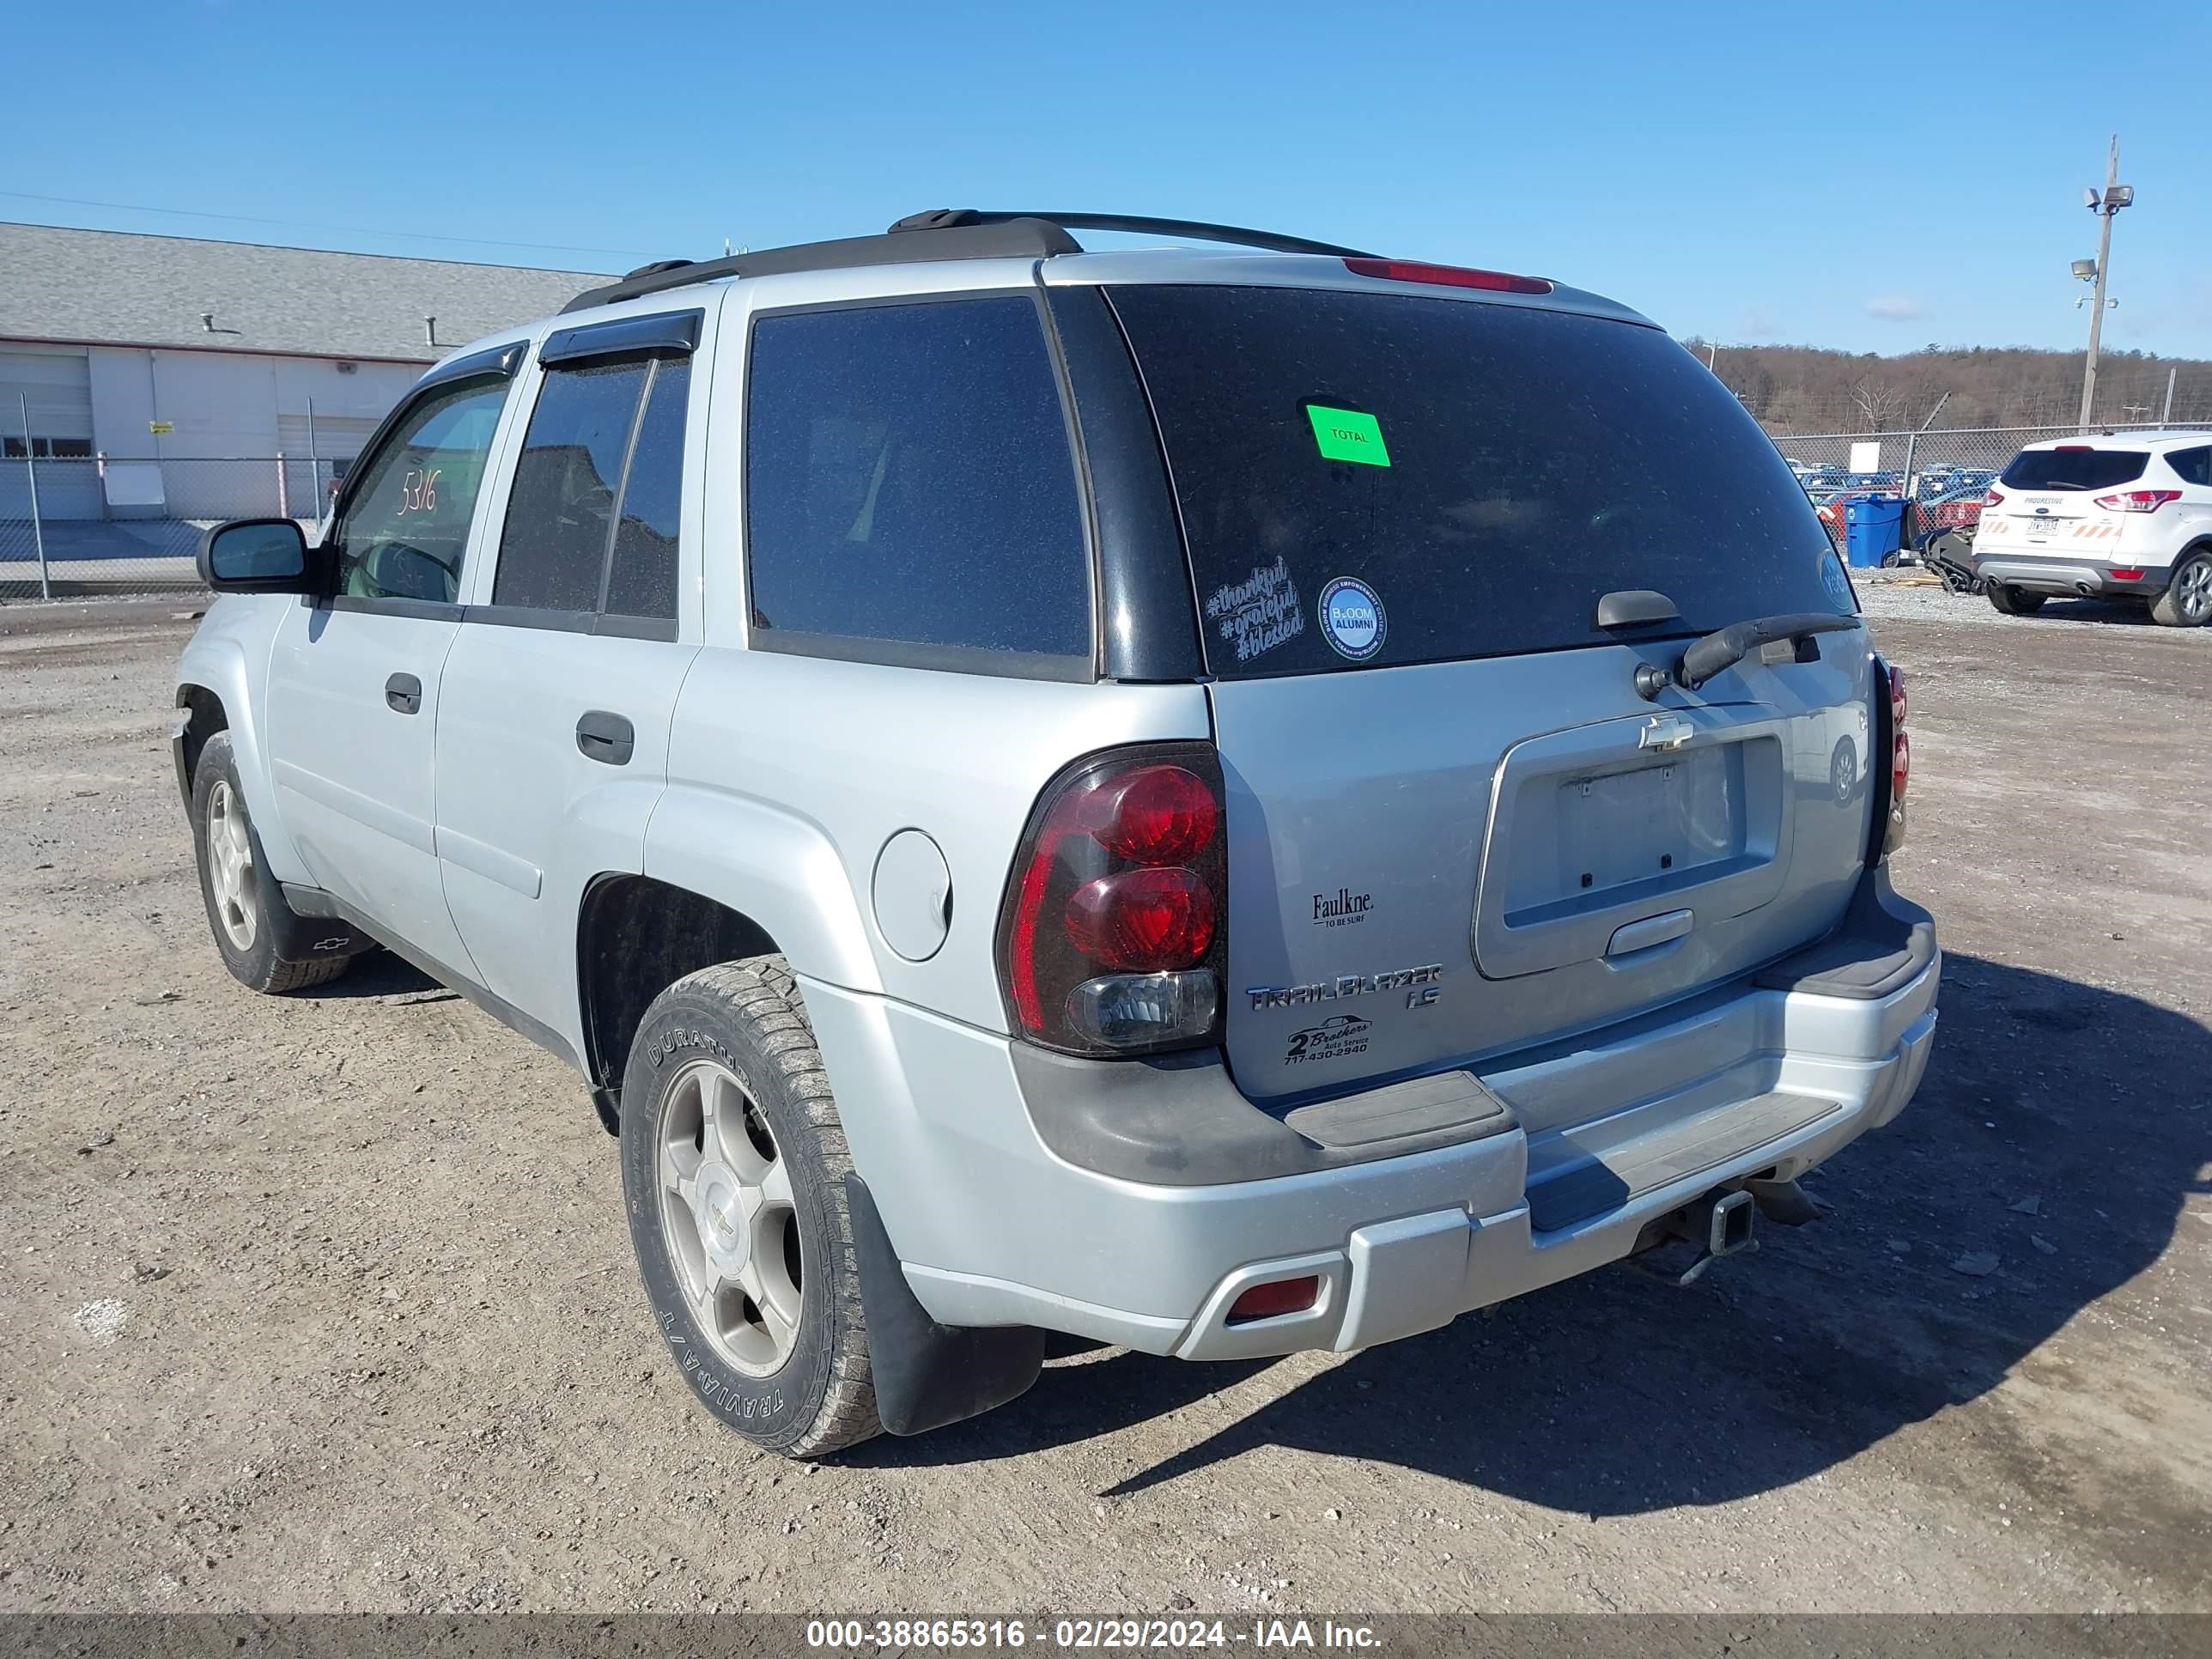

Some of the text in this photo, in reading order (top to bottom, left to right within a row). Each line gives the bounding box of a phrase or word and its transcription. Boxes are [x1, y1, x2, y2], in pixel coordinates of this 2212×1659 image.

[1329, 428, 1369, 443] TOTAL
[397, 469, 442, 516] 5316
[1206, 555, 1288, 616] #thankful
[1323, 584, 1340, 608] BUSINESS
[1340, 581, 1378, 605] EMPOWERMENT
[1221, 580, 1297, 643] #grateful
[1322, 609, 1332, 632] BLOOM
[1332, 607, 1372, 619] BLOOM
[1237, 607, 1305, 660] #blessed
[1335, 619, 1374, 629] ALUMNI
[1337, 918, 1346, 927] BE
[1246, 963, 1443, 1011] TRAILBLAZER
[1407, 988, 1442, 1010] LS
[1288, 1024, 1368, 1056] 2 Brothers
[1344, 1037, 1369, 1047] Service
[699, 1371, 785, 1419] TRAVIA
